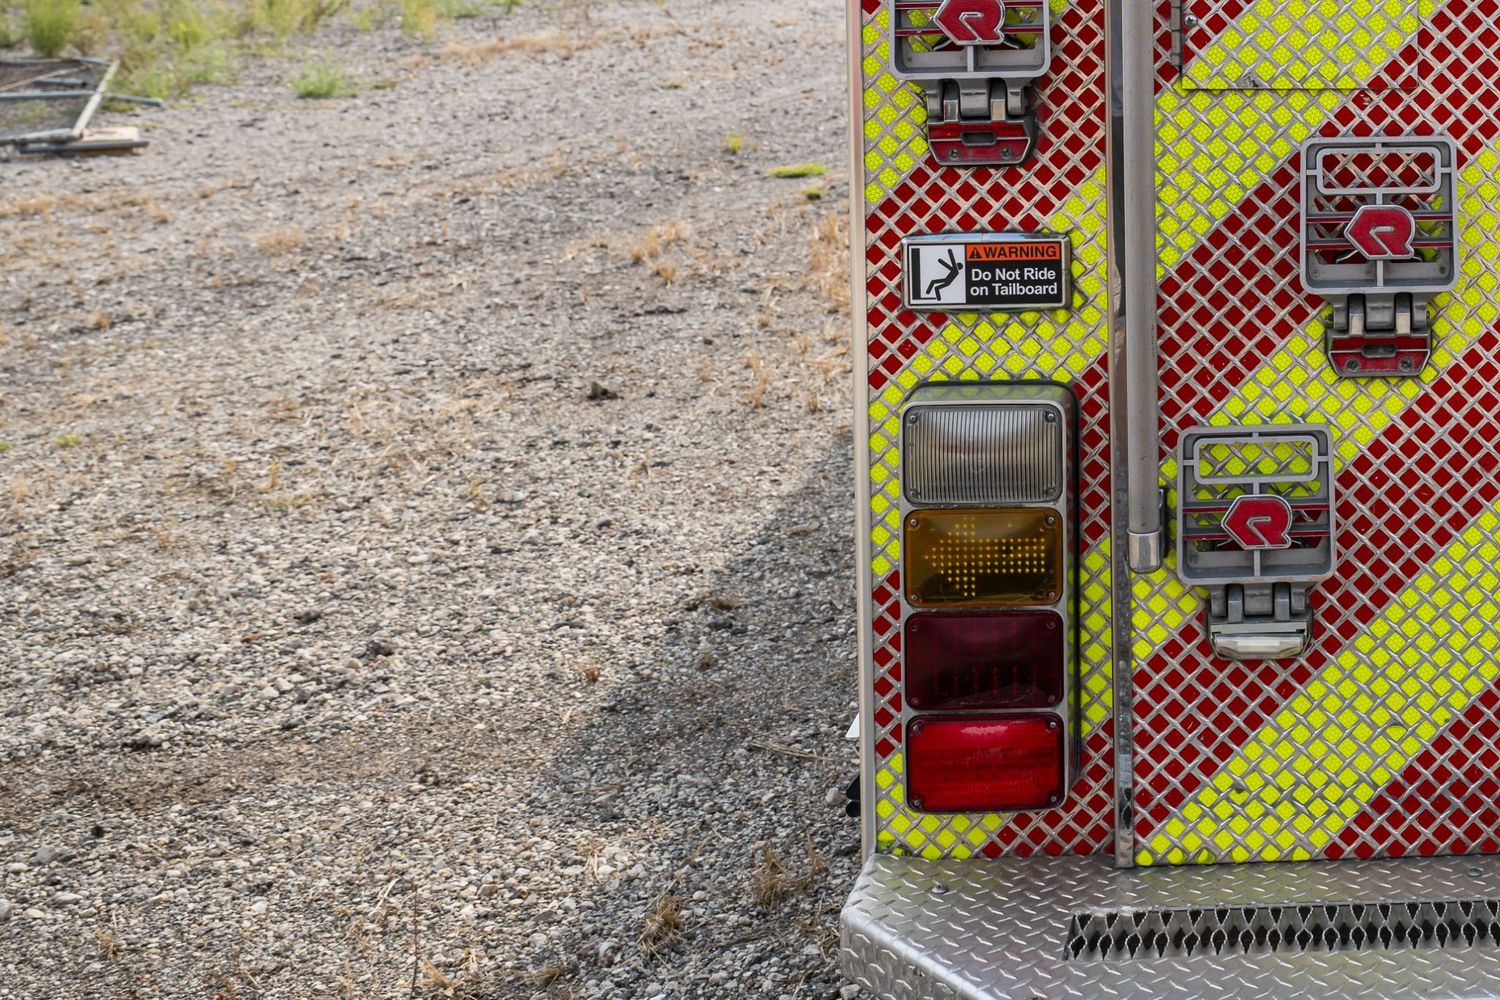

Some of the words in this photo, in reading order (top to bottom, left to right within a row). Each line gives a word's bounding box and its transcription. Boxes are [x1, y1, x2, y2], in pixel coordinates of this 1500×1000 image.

[983, 246, 1057, 259] WARNING
[971, 268, 992, 281] Do
[995, 268, 1021, 281] Not
[1024, 267, 1056, 280] Ride
[970, 286, 989, 296] on
[992, 282, 1058, 296] Tailboard
